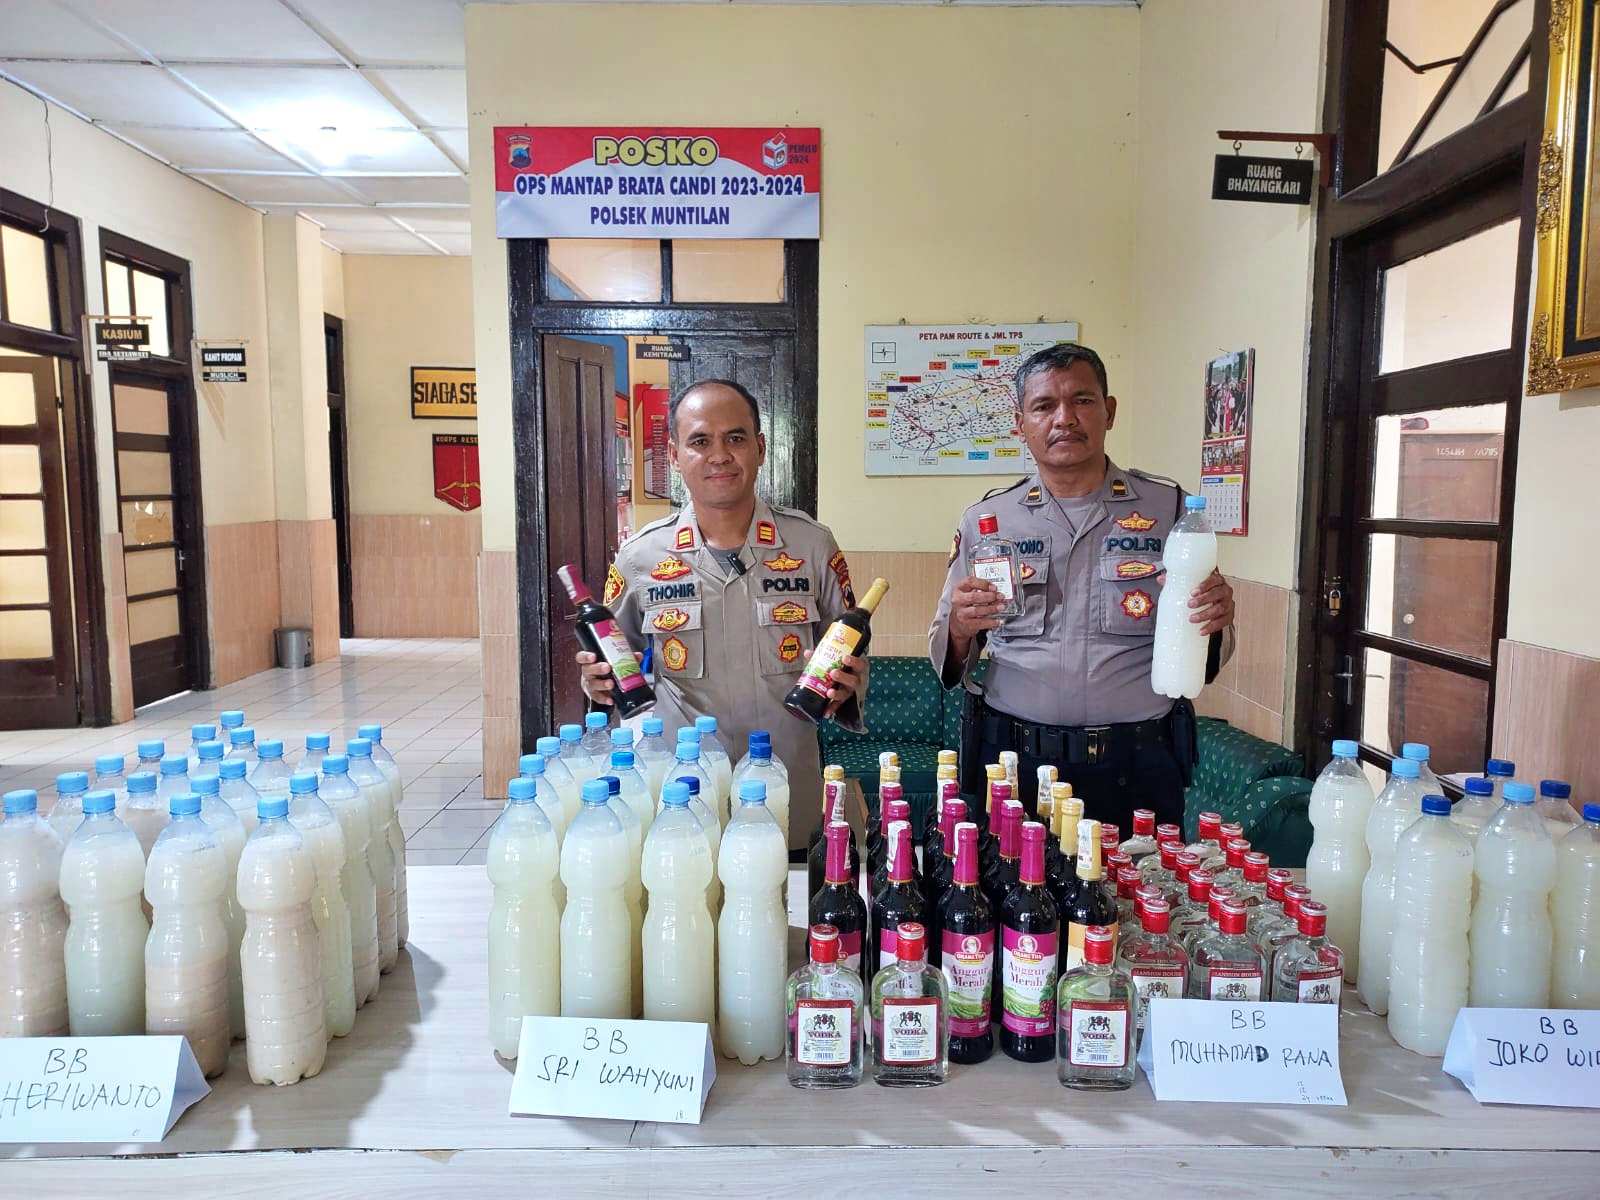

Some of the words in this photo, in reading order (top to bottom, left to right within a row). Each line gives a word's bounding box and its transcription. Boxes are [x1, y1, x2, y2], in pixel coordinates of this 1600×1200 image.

[594, 137, 718, 166] POSKO
[1246, 164, 1282, 179] RUANG
[516, 176, 546, 195] OPS
[551, 176, 613, 195] MANTAP
[618, 176, 665, 195] BRATA
[670, 176, 716, 195] CANDI
[721, 176, 803, 195] 2023-2024
[1227, 178, 1301, 195] BHAYANGKARI
[590, 206, 647, 225] POLSEK
[651, 206, 730, 225] MUNTILAN
[102, 329, 143, 340] KASIUM
[919, 332, 938, 340] PETA
[940, 332, 955, 340] PAM
[957, 332, 981, 340] ROUTE
[991, 331, 1007, 339] JML
[1008, 331, 1024, 339] TPS
[1106, 536, 1161, 552] POLRI
[647, 582, 695, 601] THOHIR
[762, 577, 810, 593] POLRI
[951, 965, 988, 978] Anggur
[1008, 962, 1046, 976] Anggur
[953, 975, 985, 988] Merah
[1010, 972, 1043, 986] Merah
[807, 1030, 842, 1038] VODKA
[894, 1027, 928, 1036] VODKA
[1081, 1032, 1117, 1040] VODKA
[1171, 1039, 1269, 1065] MUHAMAD
[1282, 1047, 1333, 1068] RANA
[1487, 1038, 1549, 1066] JOKO
[44, 1048, 88, 1079] BB
[537, 1054, 579, 1084] SRI
[599, 1062, 694, 1094] WAHYUNI
[0, 1080, 161, 1117] HERIWANTO
